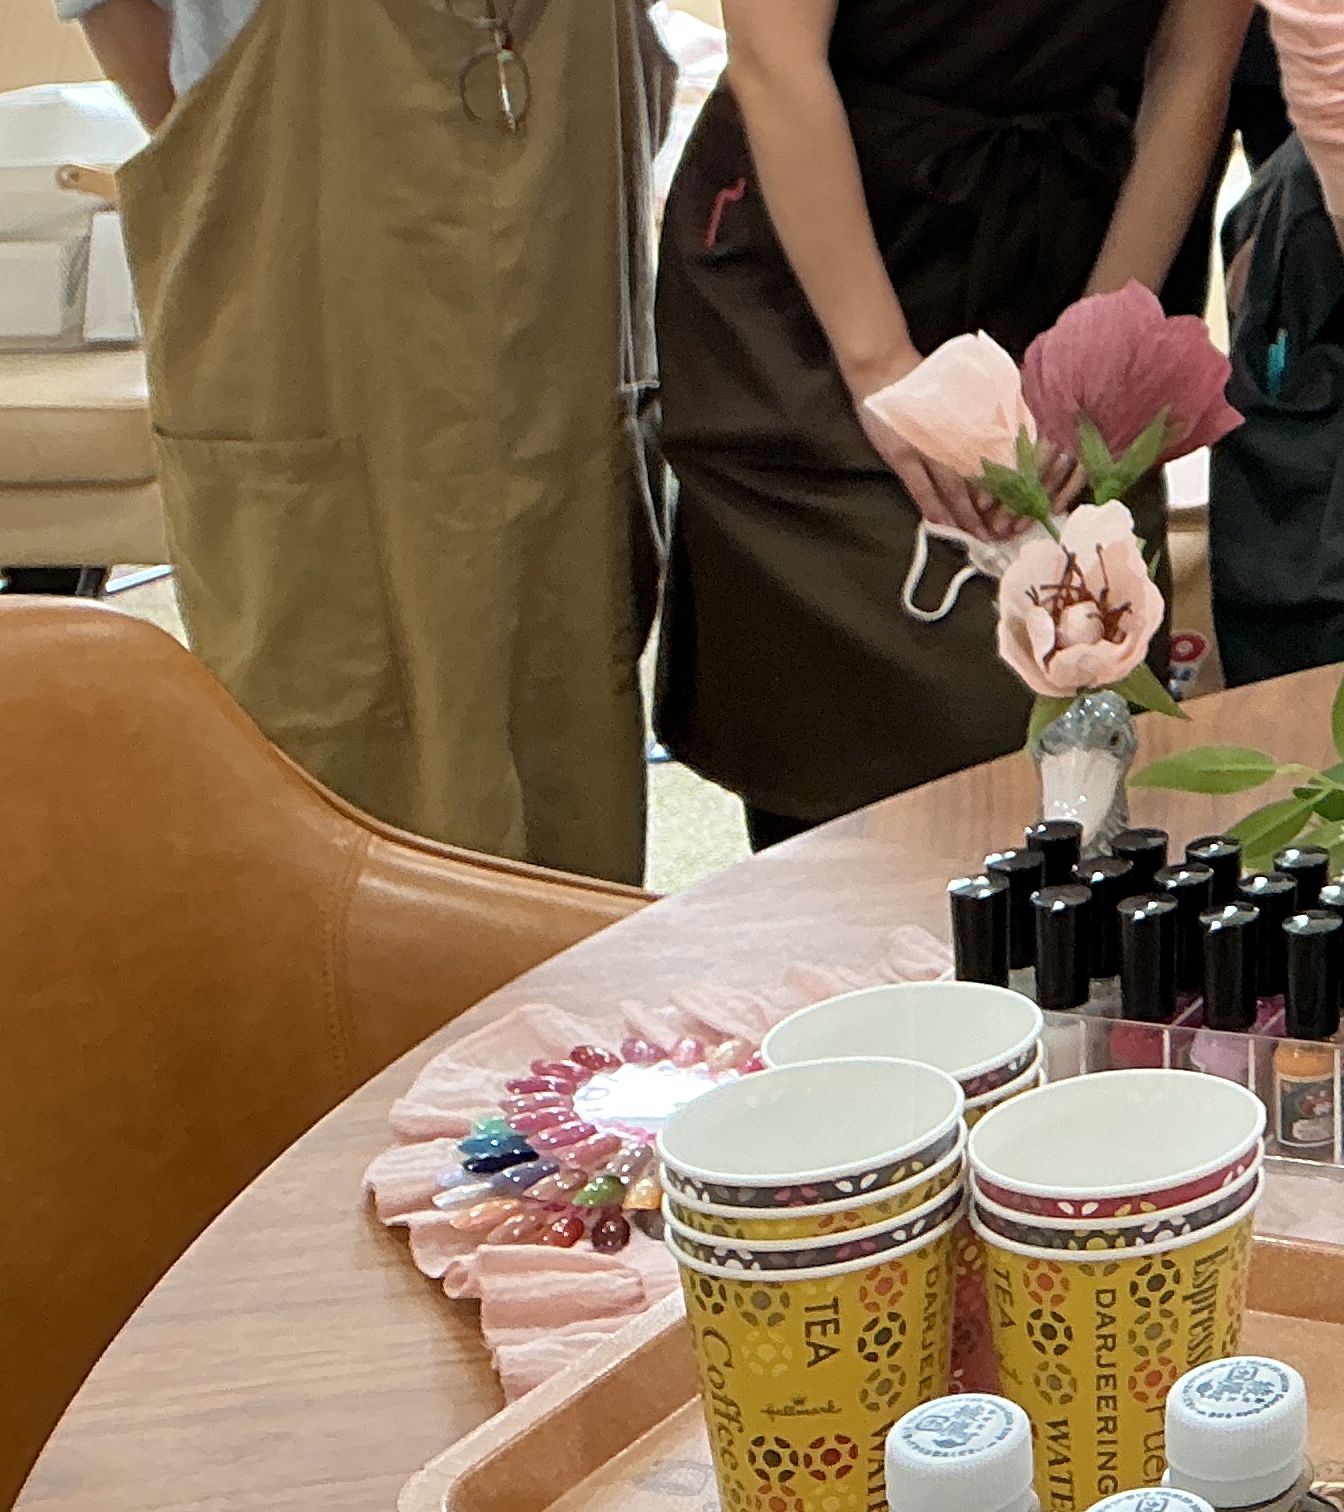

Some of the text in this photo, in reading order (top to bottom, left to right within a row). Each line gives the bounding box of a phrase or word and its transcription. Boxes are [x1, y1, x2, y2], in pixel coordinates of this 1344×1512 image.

[804, 1295, 841, 1369] TEA
[1182, 1245, 1229, 1365] Espress
[702, 1325, 744, 1472] Coffee
[1095, 1288, 1119, 1496] DARJEERING
[1046, 1419, 1076, 1512] WATE
